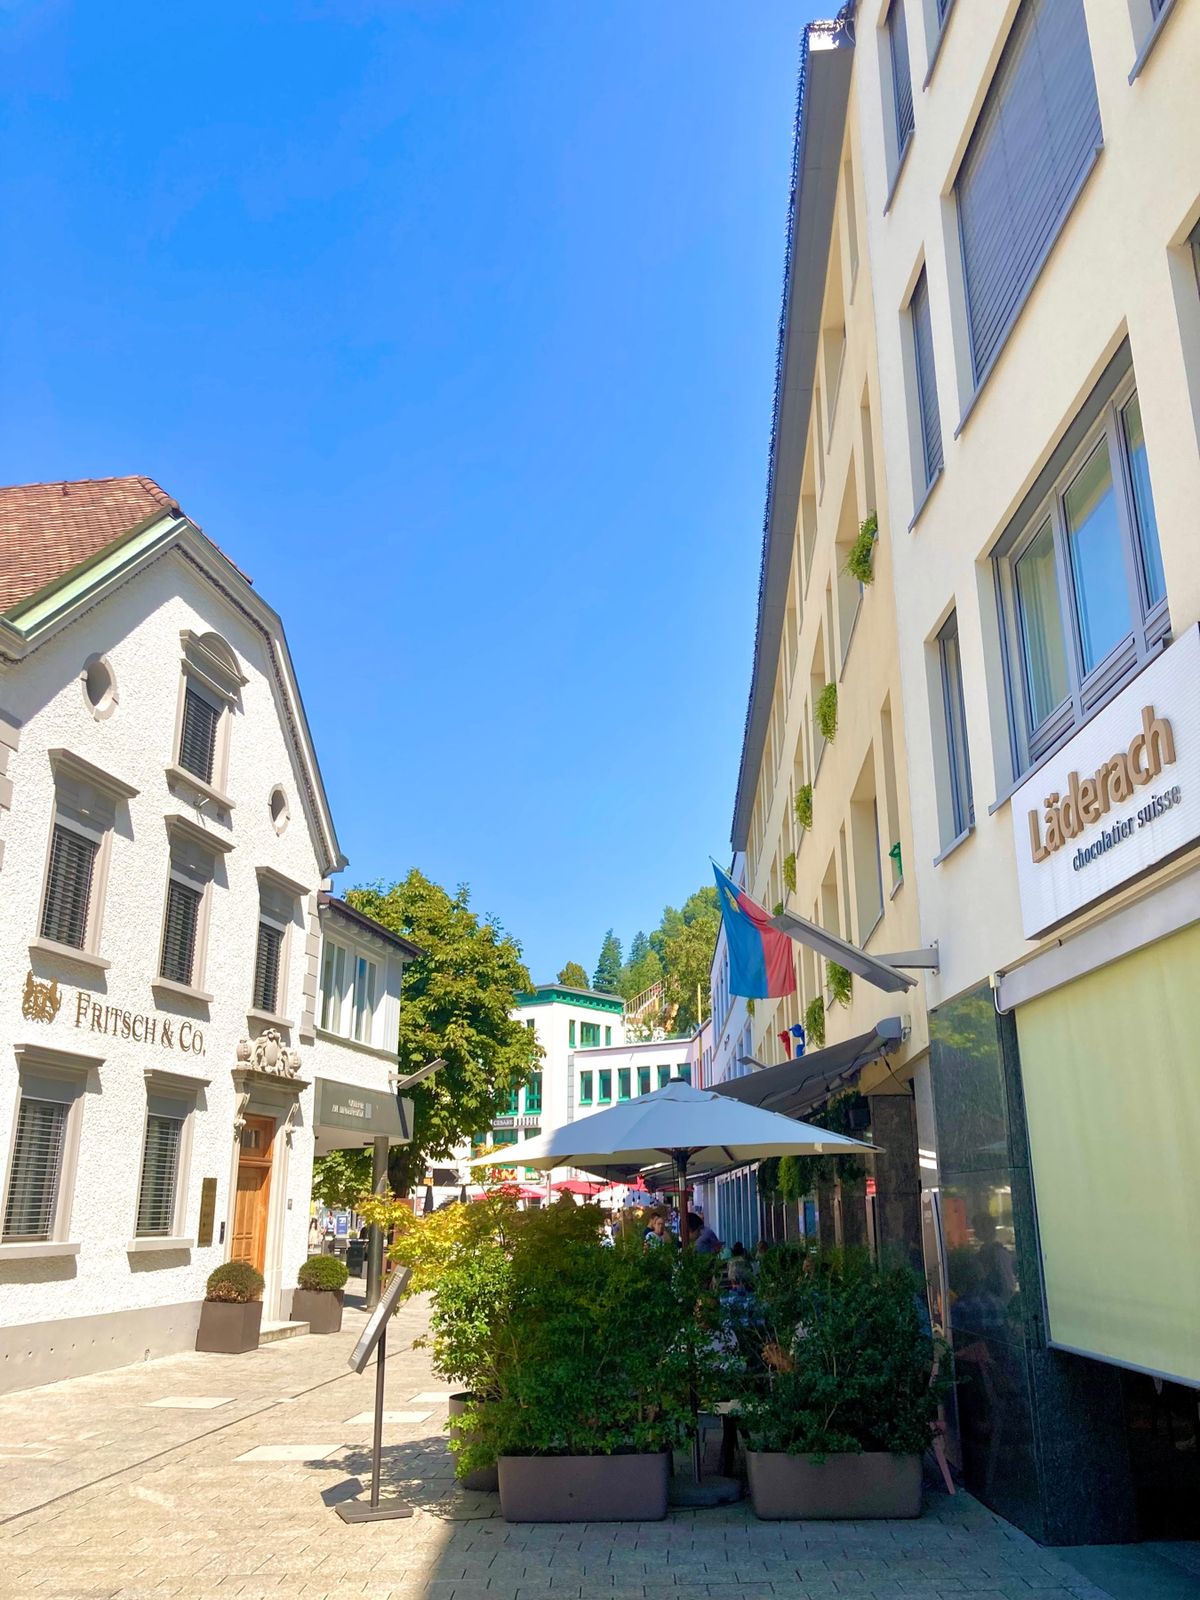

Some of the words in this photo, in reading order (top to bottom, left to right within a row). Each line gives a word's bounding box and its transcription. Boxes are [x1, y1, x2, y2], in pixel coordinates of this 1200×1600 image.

[1028, 705, 1176, 863] Läderach
[1072, 820, 1134, 871] chocolatier
[1137, 785, 1182, 829] suisse
[74, 991, 157, 1044] FRITSCH
[161, 1018, 175, 1049] &
